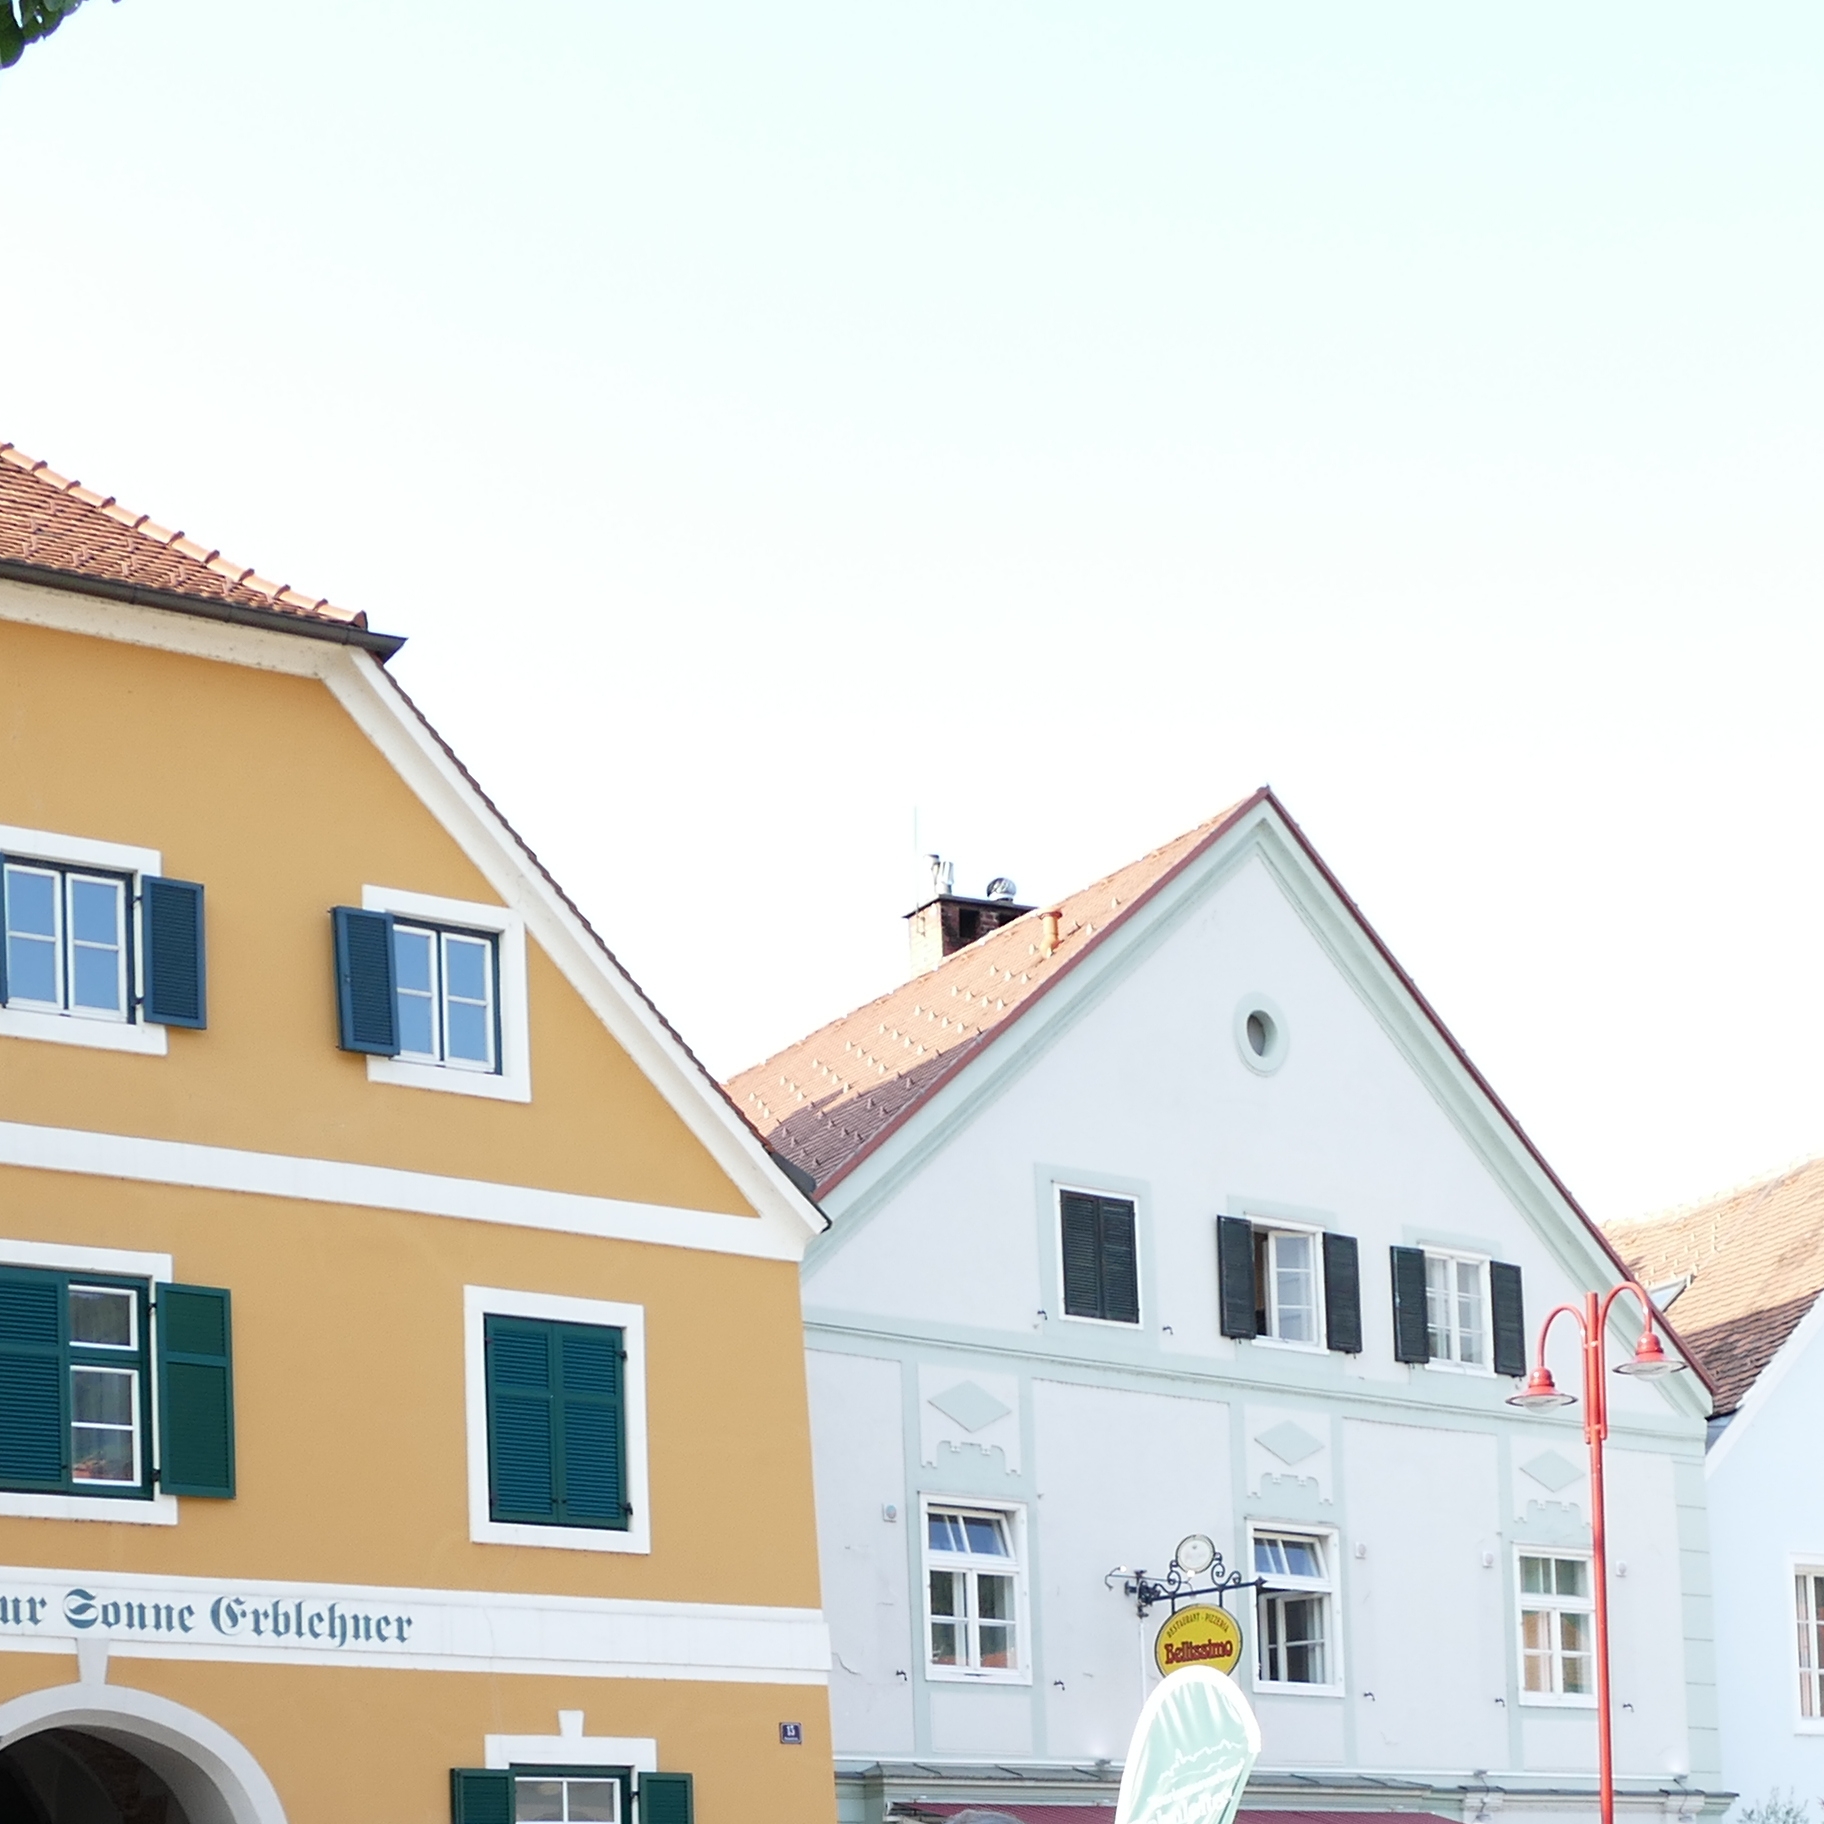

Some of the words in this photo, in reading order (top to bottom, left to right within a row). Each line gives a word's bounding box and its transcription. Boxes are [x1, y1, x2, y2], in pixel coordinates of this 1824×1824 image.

[63, 1588, 196, 1634] Sonne
[210, 1595, 413, 1648] Erblehner
[1164, 1639, 1233, 1665] Bellissimo
